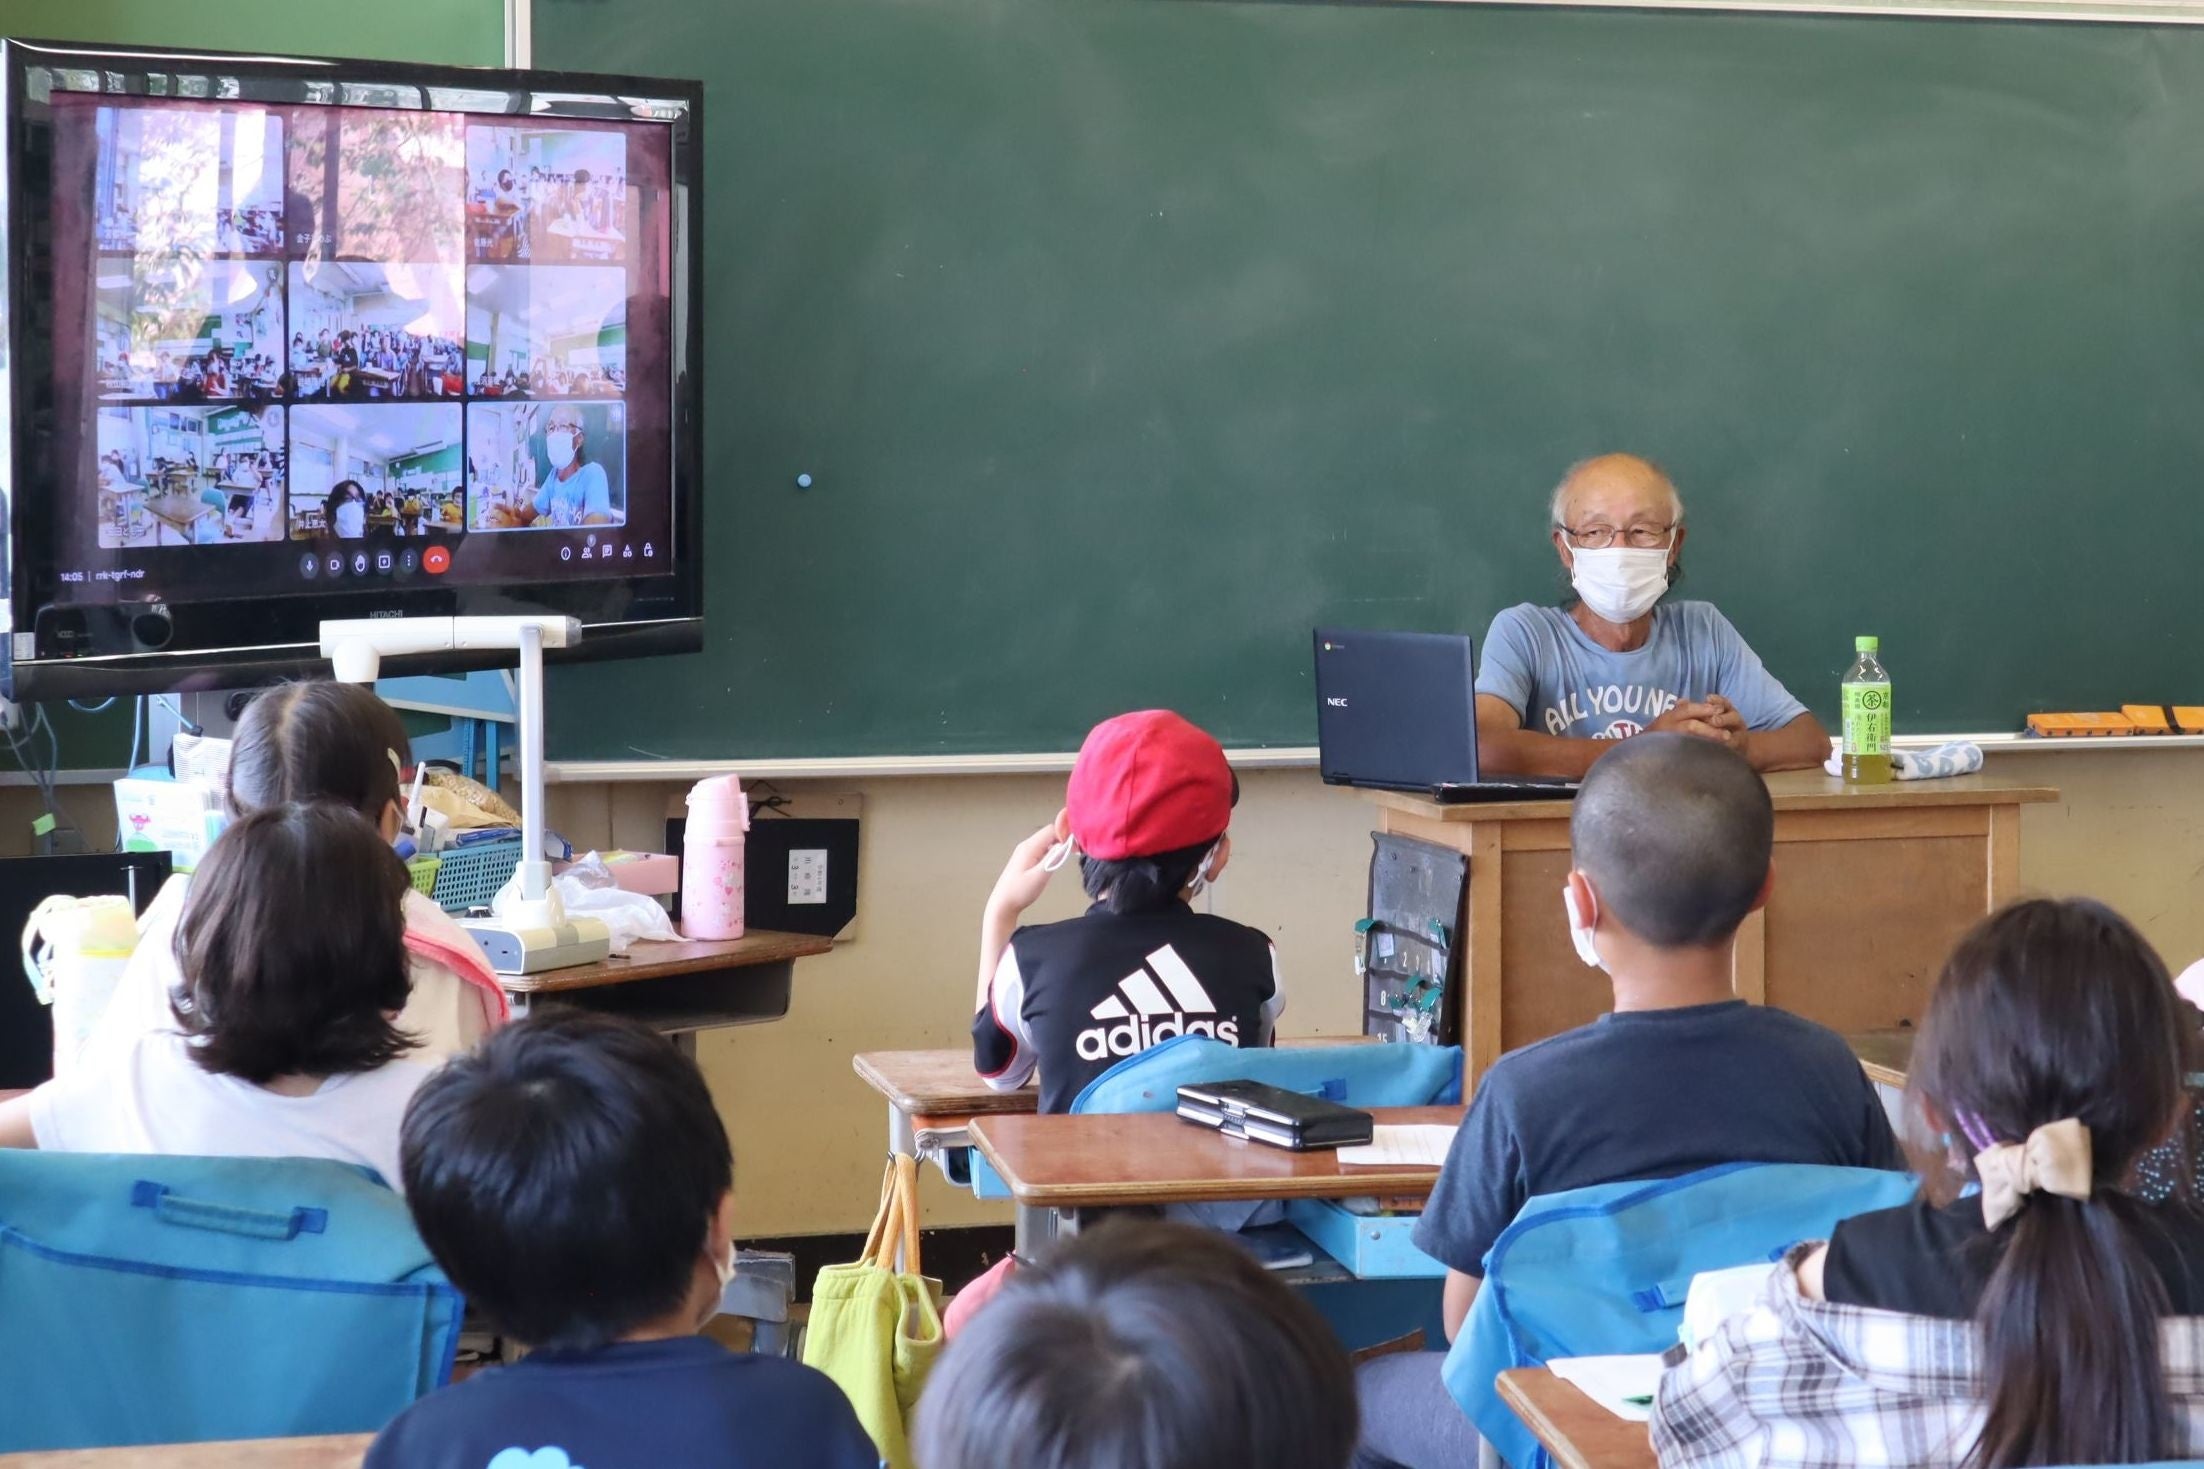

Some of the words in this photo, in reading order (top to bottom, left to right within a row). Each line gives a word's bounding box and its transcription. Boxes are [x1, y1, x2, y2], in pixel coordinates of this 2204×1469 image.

[60, 572, 84, 582] 14:05
[369, 609, 403, 619] HITACHI
[1327, 697, 1348, 707] NEC
[1865, 692, 1879, 708] 茶
[1545, 692, 1588, 736] ALL
[1586, 684, 1643, 715] YOU
[1866, 713, 1876, 752] 伊右衛門
[1380, 990, 1387, 1006] 8
[1075, 1011, 1239, 1061] adidas
[1376, 1032, 1388, 1044] 15
